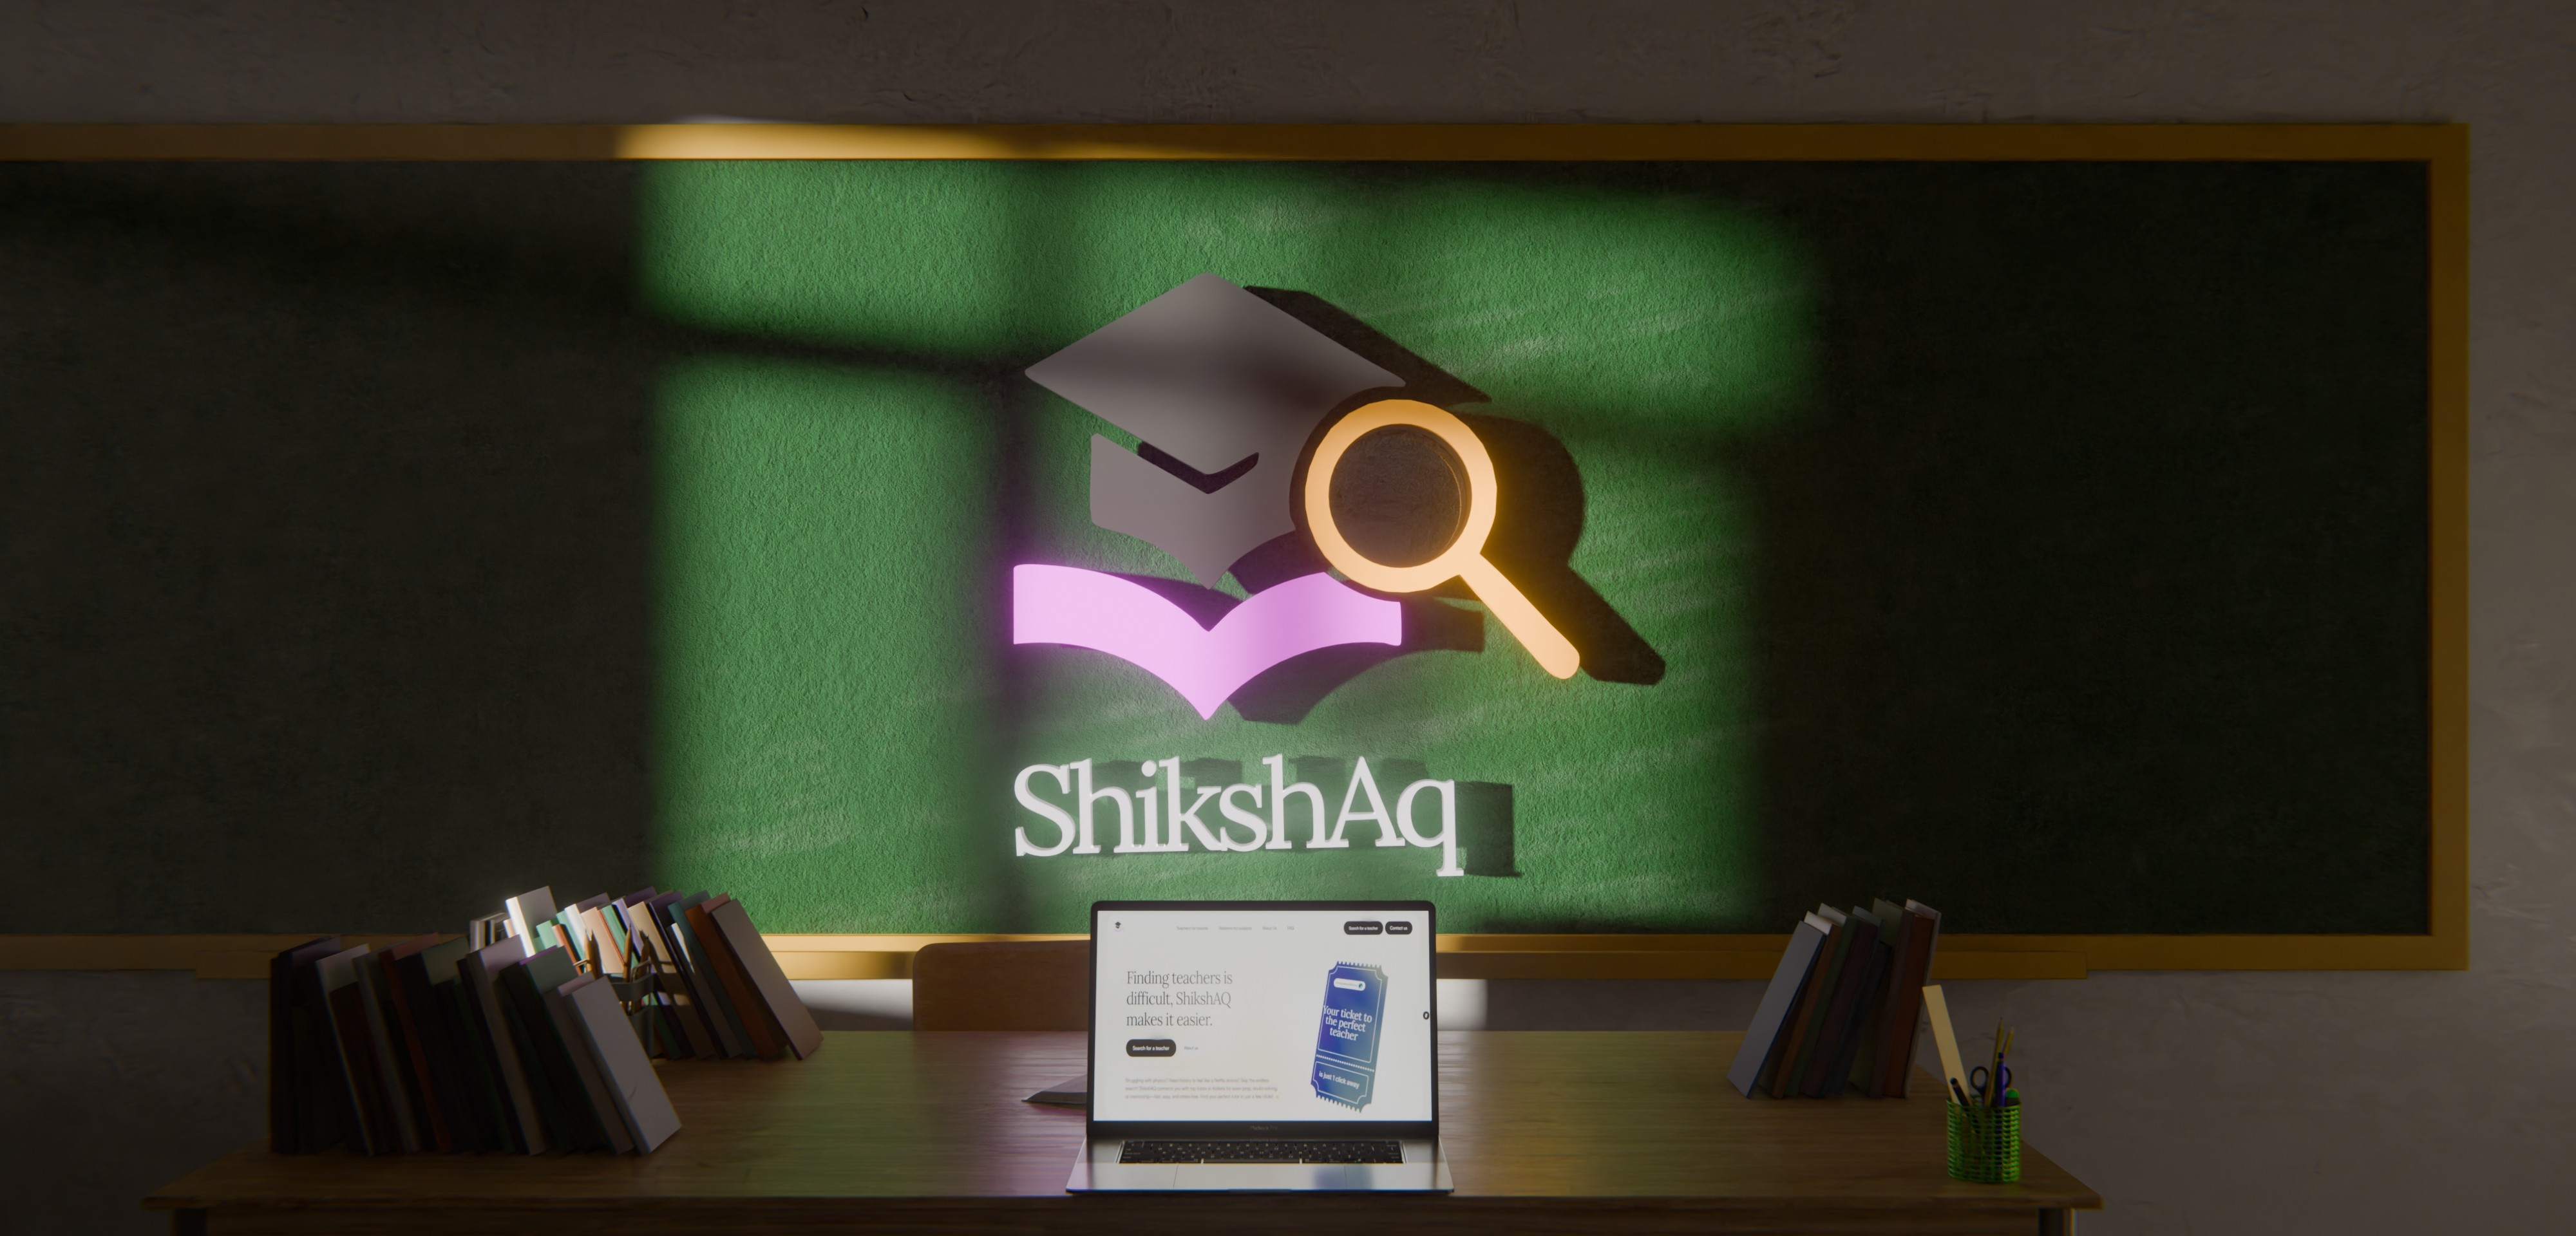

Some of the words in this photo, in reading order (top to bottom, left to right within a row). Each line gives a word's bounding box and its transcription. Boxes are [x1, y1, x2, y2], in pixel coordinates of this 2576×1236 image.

[1014, 753, 1464, 877] ShikshAq
[1127, 971, 1170, 989] Finding
[1172, 971, 1221, 984] teachers
[1224, 971, 1233, 984] is
[1126, 991, 1173, 1007] difficult,
[1176, 991, 1231, 1008] ShikshAQ
[1126, 1013, 1163, 1026] makes
[1166, 1013, 1174, 1026] it
[1177, 1013, 1213, 1026] easier.
[1323, 1005, 1340, 1016] Your
[1341, 1008, 1363, 1020] ticket
[1363, 1013, 1372, 1023] to
[1325, 1016, 1338, 1026] the
[1338, 1018, 1366, 1033] perfect
[1330, 1027, 1359, 1041] teacher
[1323, 1072, 1332, 1081] just
[1335, 1076, 1346, 1085] click
[1346, 1079, 1360, 1090] away
